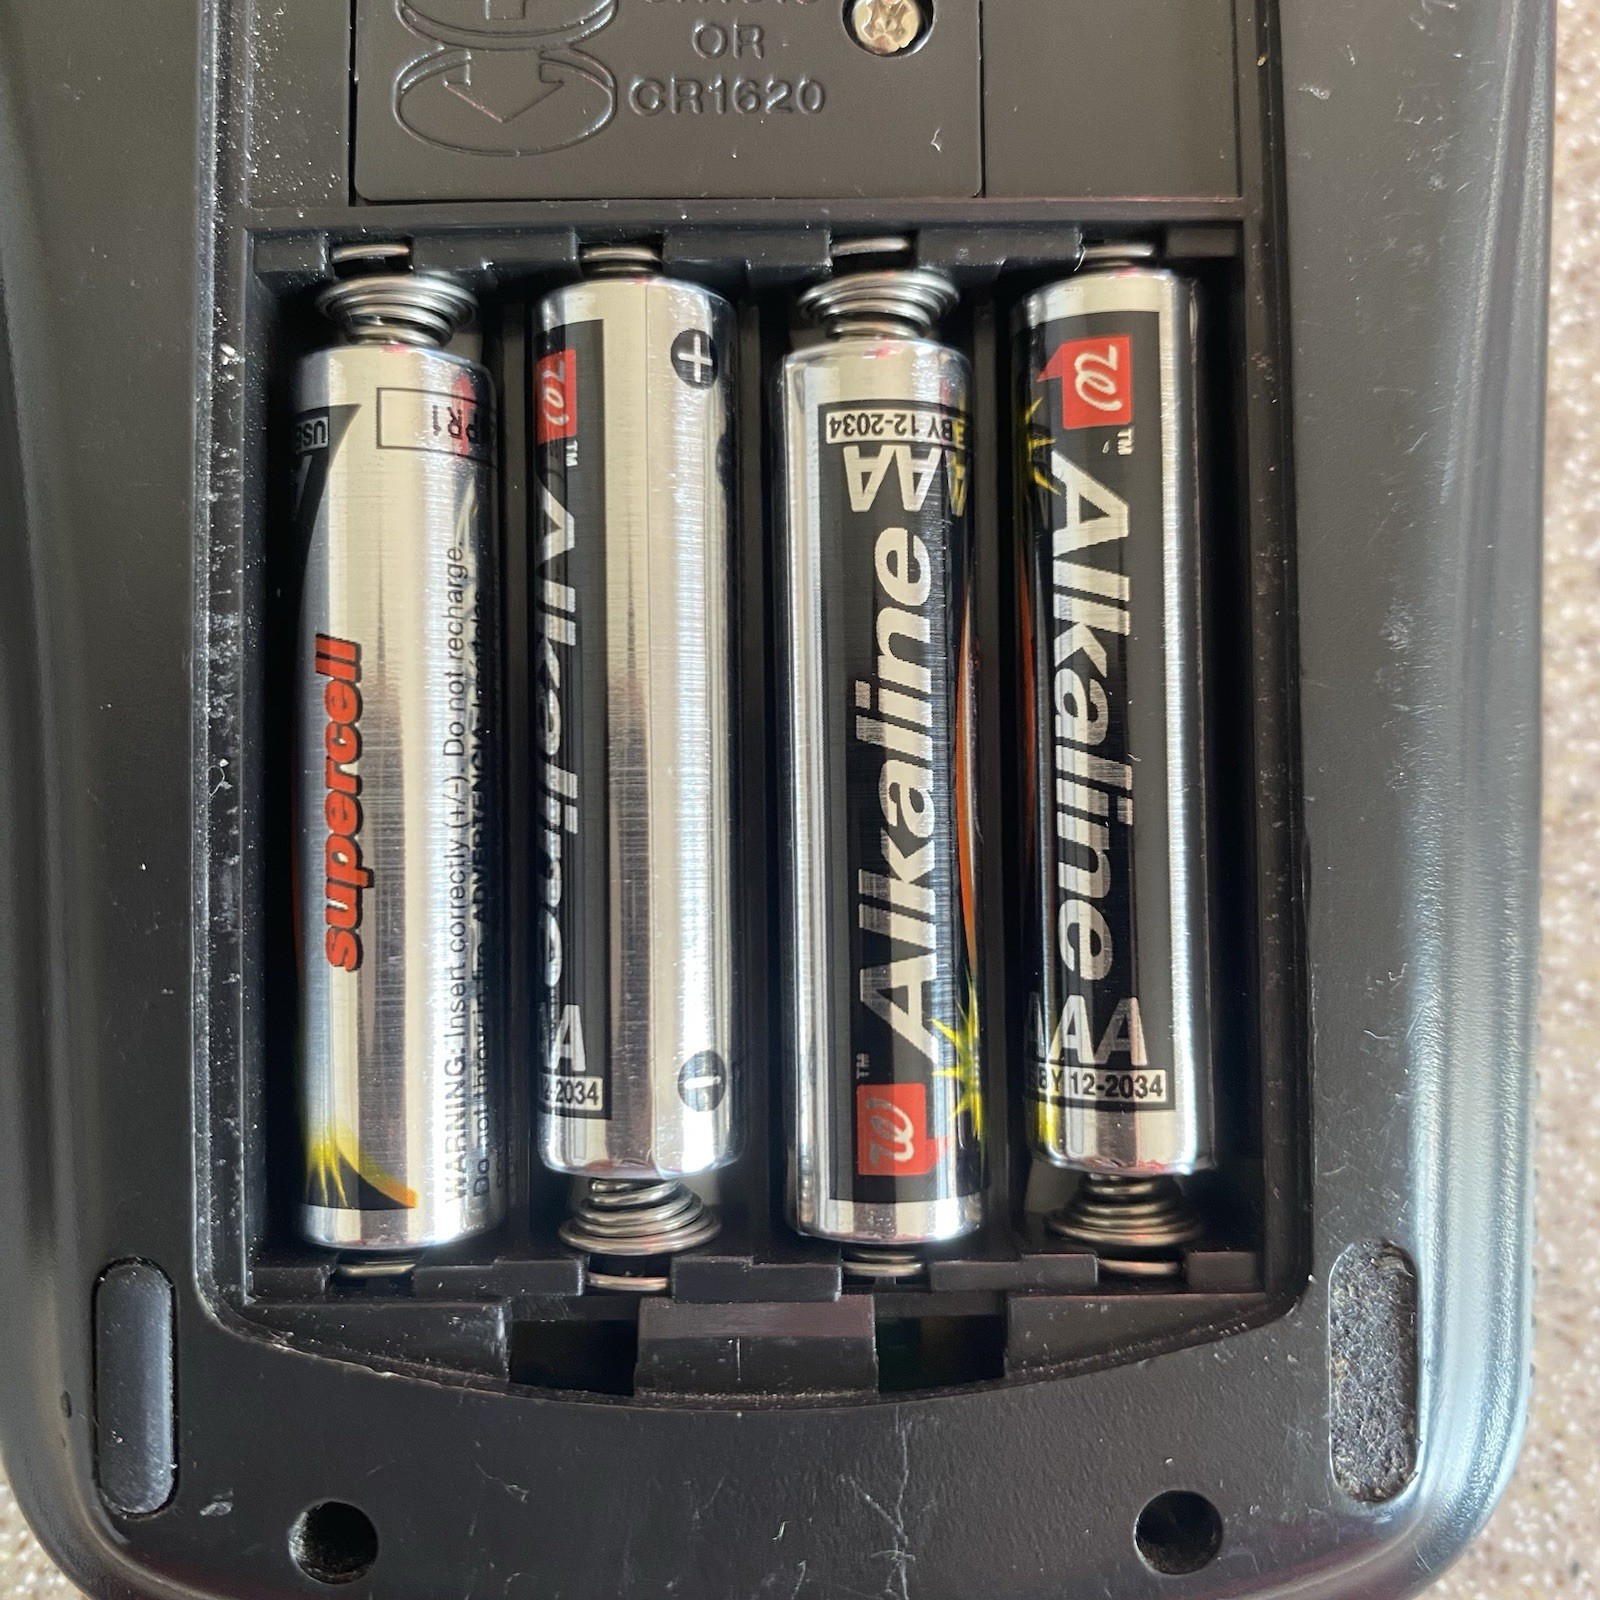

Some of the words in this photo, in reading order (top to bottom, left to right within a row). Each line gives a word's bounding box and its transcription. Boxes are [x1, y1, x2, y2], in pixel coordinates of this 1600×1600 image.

[691, 19, 765, 59] OR
[628, 75, 825, 116] CR1620
[828, 412, 920, 439] 12-2034
[441, 540, 469, 661] recharge.
[444, 670, 465, 712] not
[1052, 449, 1133, 981] Alkaline
[443, 721, 465, 757] Do
[315, 633, 374, 972] supercell
[855, 527, 939, 1065] Alkaline
[443, 839, 470, 953] correctly
[444, 964, 467, 1038] Insert
[1071, 1072, 1164, 1099] 12-2034
